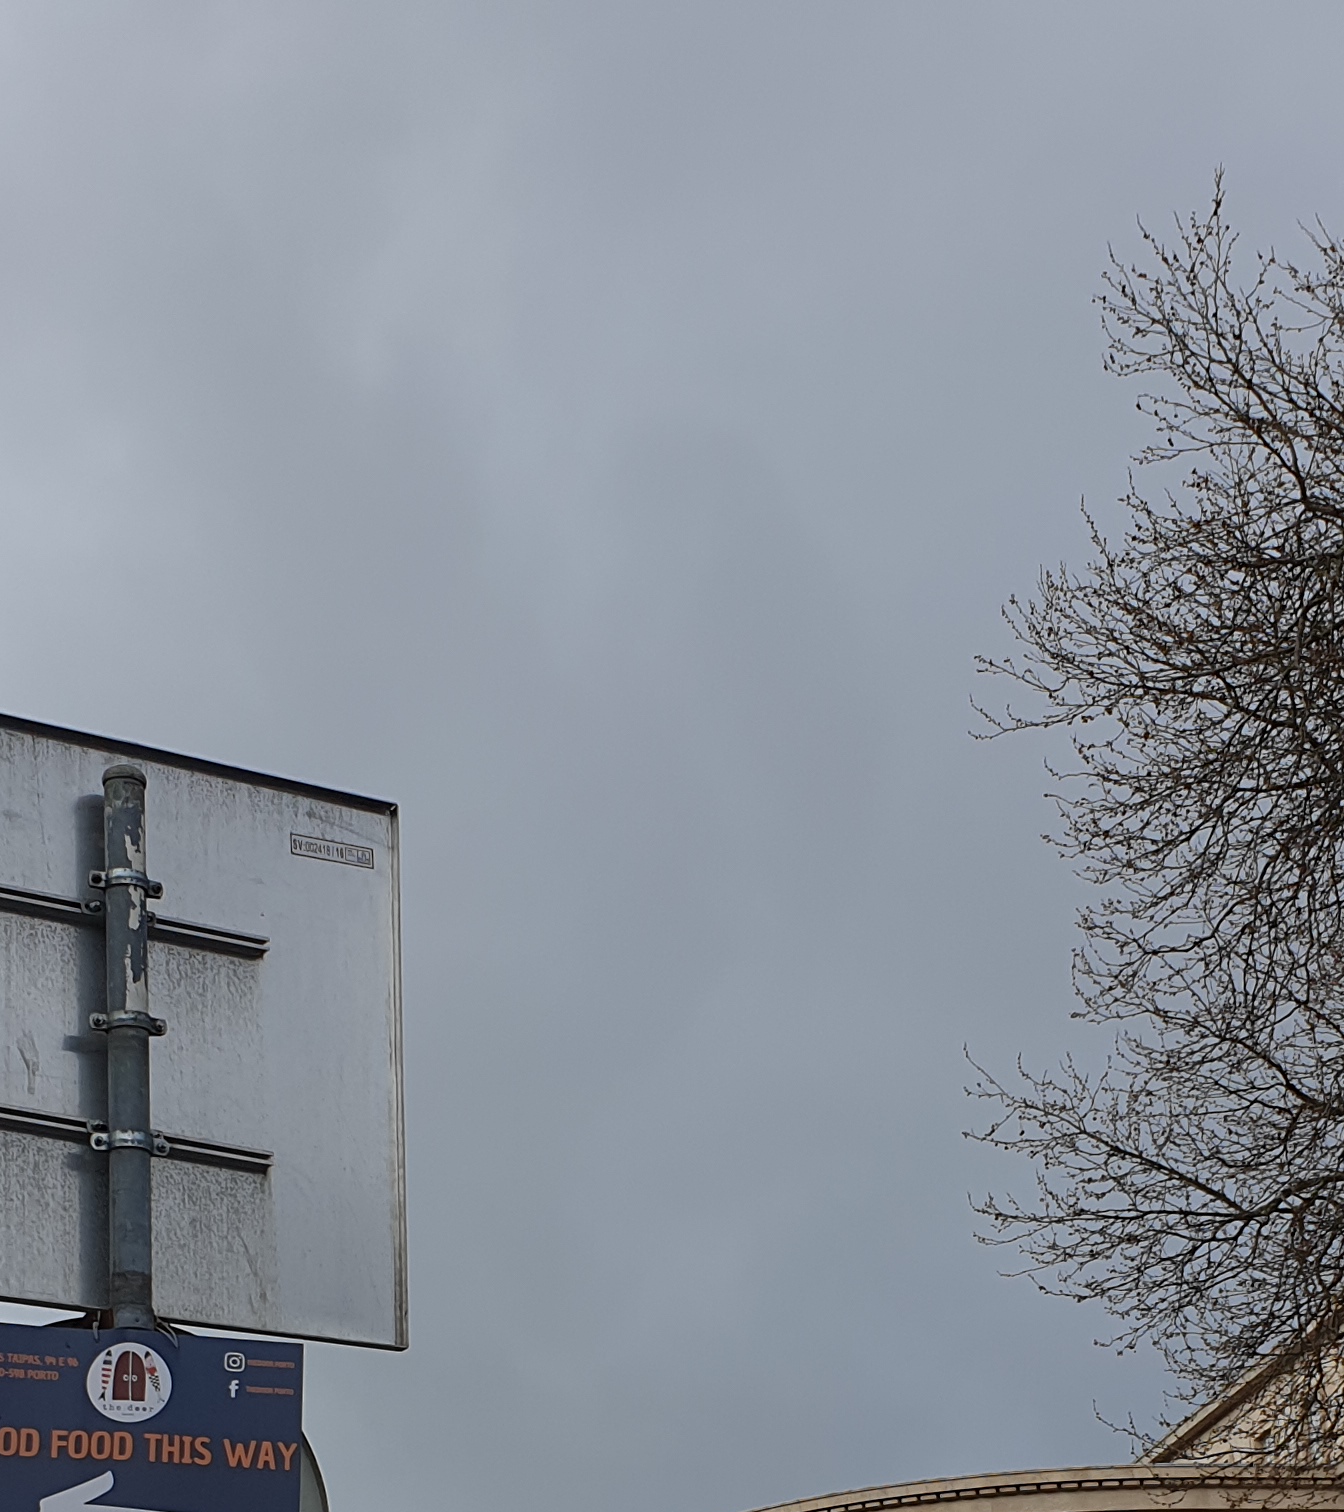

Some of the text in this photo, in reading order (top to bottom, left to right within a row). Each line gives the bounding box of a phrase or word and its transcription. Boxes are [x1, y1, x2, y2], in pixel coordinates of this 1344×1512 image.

[50, 1430, 134, 1461] FOOD
[144, 1432, 213, 1466] THIS
[223, 1438, 298, 1471] WAY
